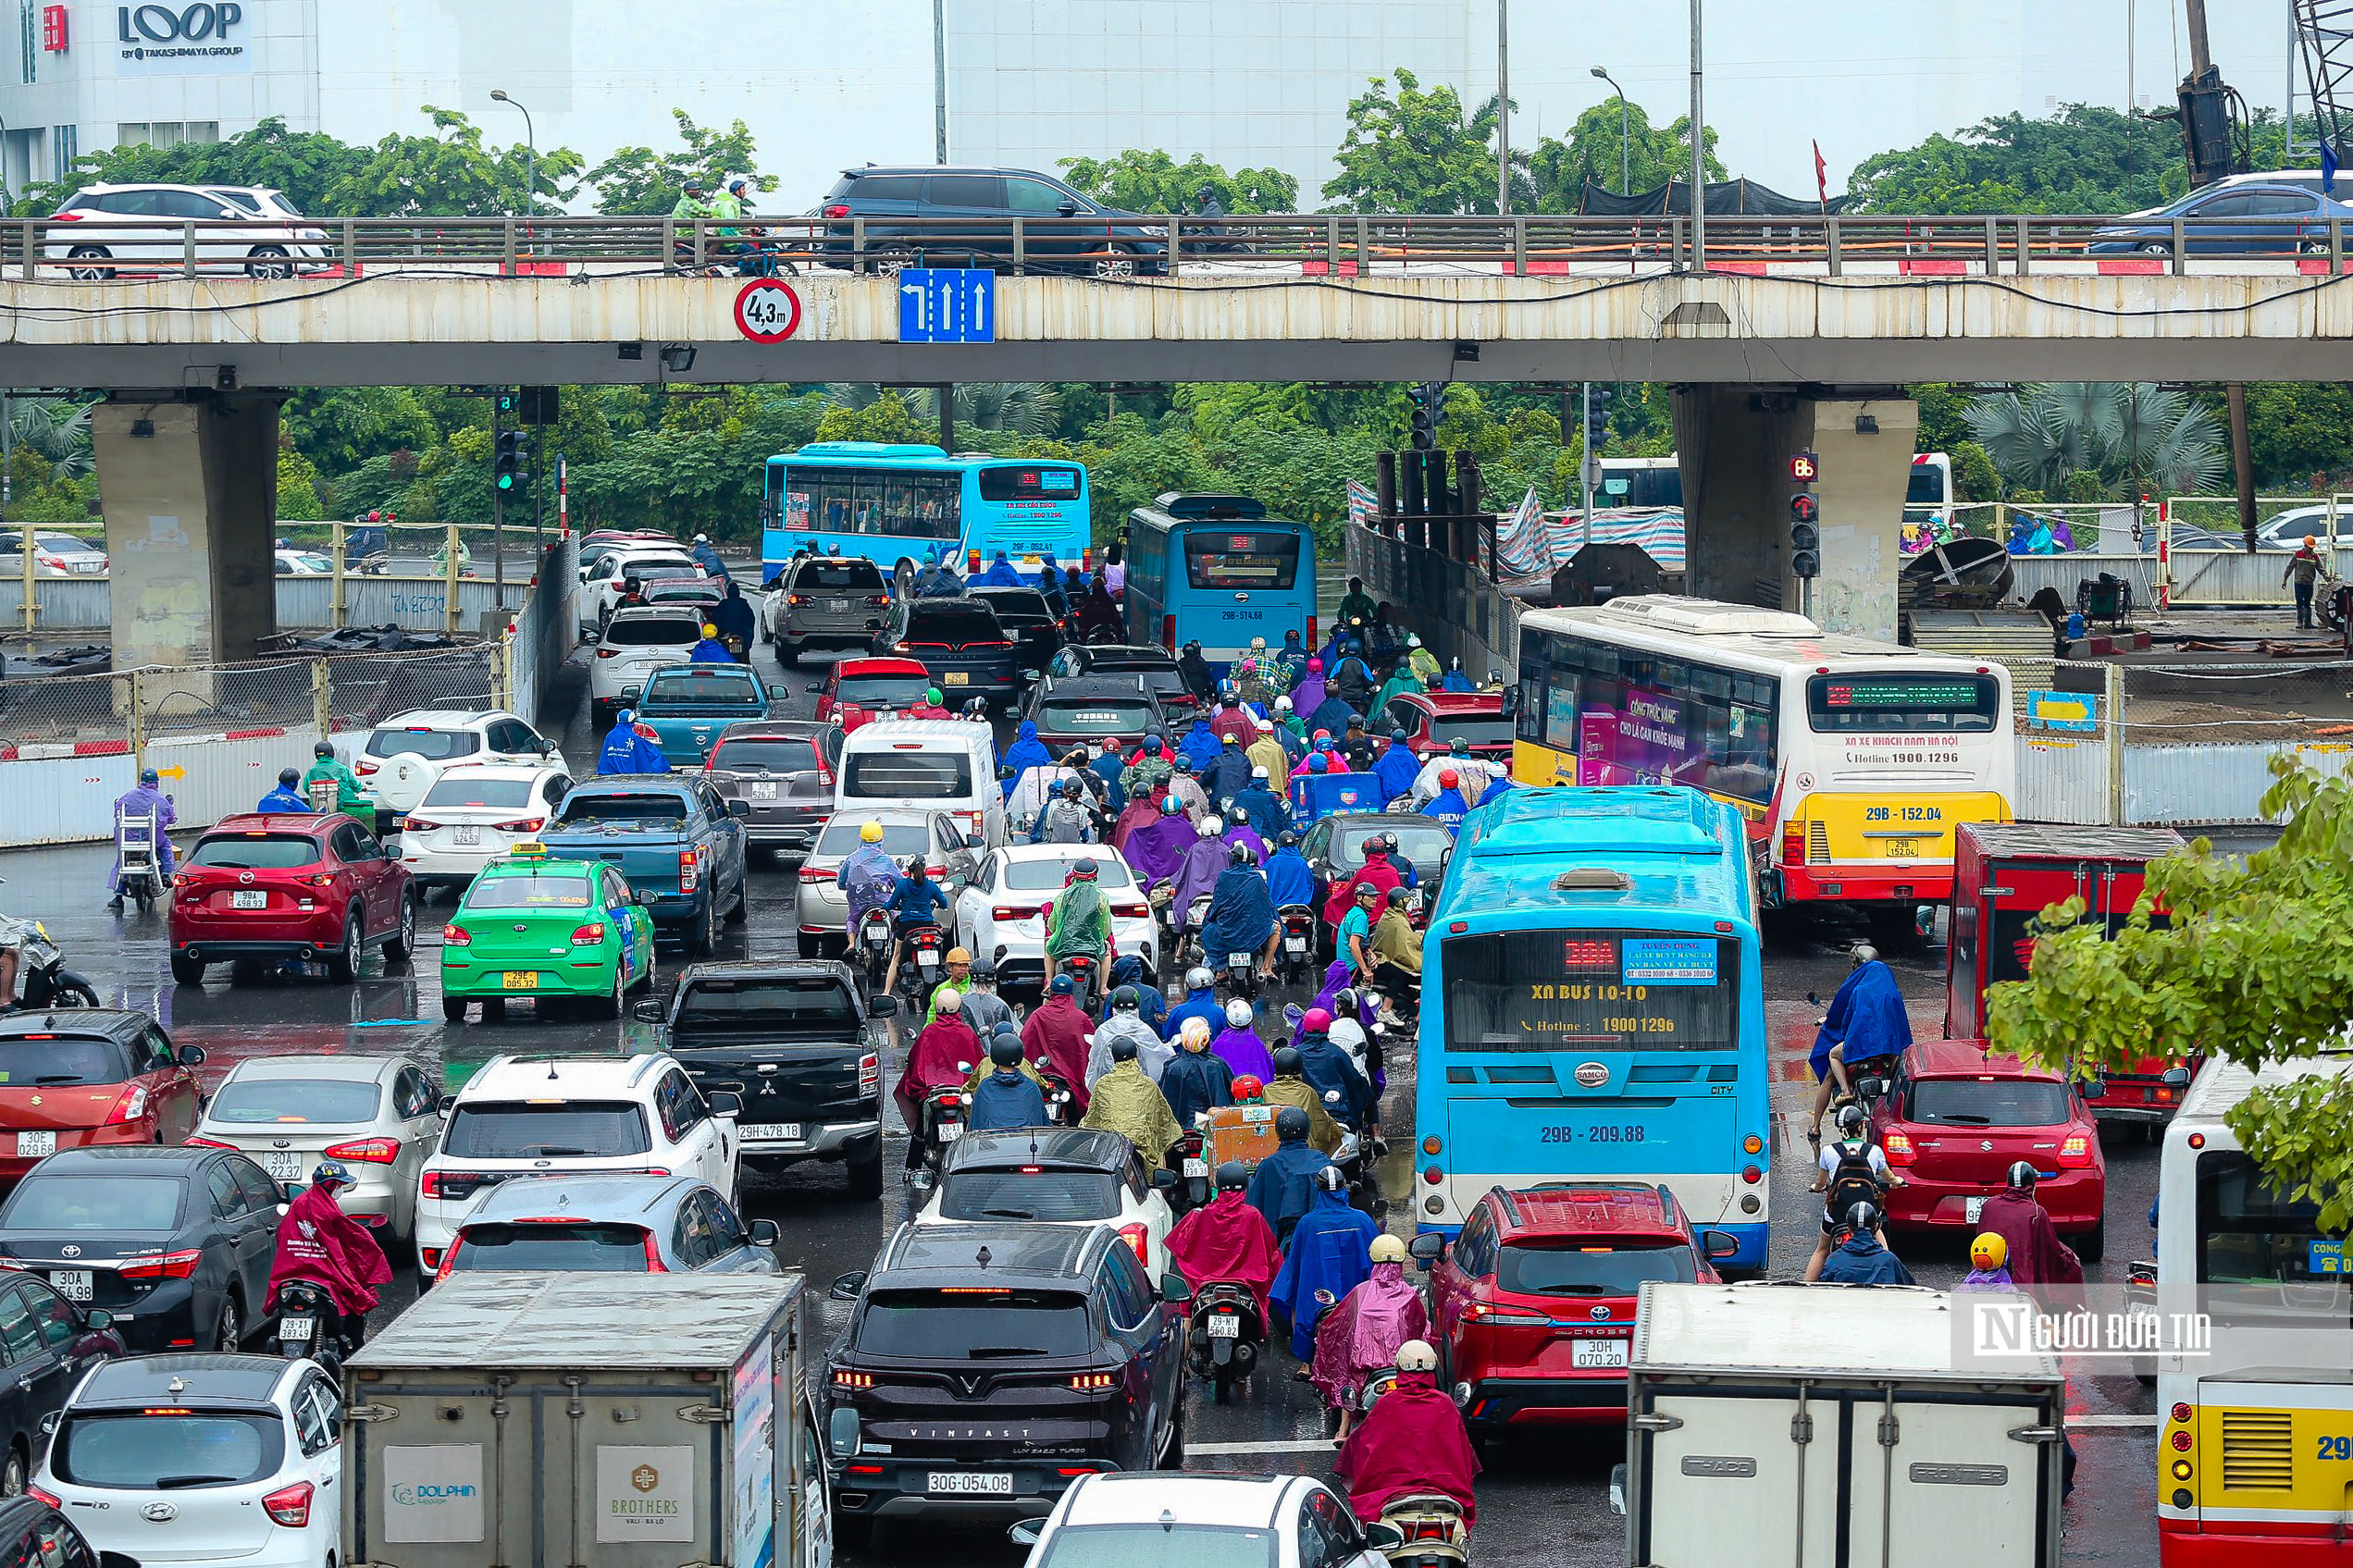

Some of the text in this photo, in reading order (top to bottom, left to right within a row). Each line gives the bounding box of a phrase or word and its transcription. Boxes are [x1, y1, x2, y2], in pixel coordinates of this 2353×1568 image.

[118, 2, 241, 43] LOOP
[121, 46, 243, 58] BY TAKASHIMAYA GROUP
[1221, 611, 1264, 621] 29B-514.68
[1630, 698, 1677, 723] CÔNG THỨC VÀNG
[1620, 721, 1686, 752] CHO LÁ GAN KHỎE MẠNH
[1859, 737, 1870, 746] XE
[1872, 735, 1902, 747] KHÁCH
[1903, 736, 1925, 747] NAM
[1927, 735, 1939, 747] HÀ
[1941, 735, 1959, 747] NỘI
[1854, 752, 1959, 764] Hotline 1900.1296
[757, 783, 773, 791] 30E
[1438, 813, 1461, 823] BIDV
[1866, 808, 1889, 821] 29B
[1900, 808, 1942, 821] 152.04
[460, 826, 474, 834] 30E
[1895, 840, 1910, 848] 29B
[236, 899, 263, 907] 498.93
[1559, 985, 1591, 1000] BUS
[1598, 985, 1647, 1001] 10-10
[1537, 1020, 1580, 1031] Hotline
[1603, 1018, 1637, 1032] 1900
[1640, 1018, 1675, 1032] 1296
[1576, 1071, 1607, 1080] SAMCO
[1711, 1085, 1734, 1095] CITY
[27, 1131, 47, 1143] 30E
[739, 1125, 799, 1139] 29H-478.18
[1541, 1126, 1573, 1143] 29B
[1589, 1125, 1645, 1143] 209.88
[19, 1144, 54, 1155] 029.68
[272, 1153, 292, 1165] 30A
[2313, 1242, 2342, 1253] CÔNG
[59, 1271, 83, 1285] 30A
[58, 1286, 92, 1300] 54.98
[285, 1319, 308, 1328] 29-X1
[1213, 1316, 1234, 1326] 29-N1
[281, 1328, 309, 1338] 383.49
[1589, 1340, 1613, 1352] 30H
[1579, 1353, 1622, 1365] 070.20
[910, 1428, 1030, 1438] VINFAST
[1686, 1459, 1752, 1473] THACO
[930, 1475, 1009, 1491] 30G-054.08
[417, 1485, 477, 1498] DOLPHIN
[611, 1500, 678, 1514] BROTHERS
[625, 1517, 640, 1525] VALI
